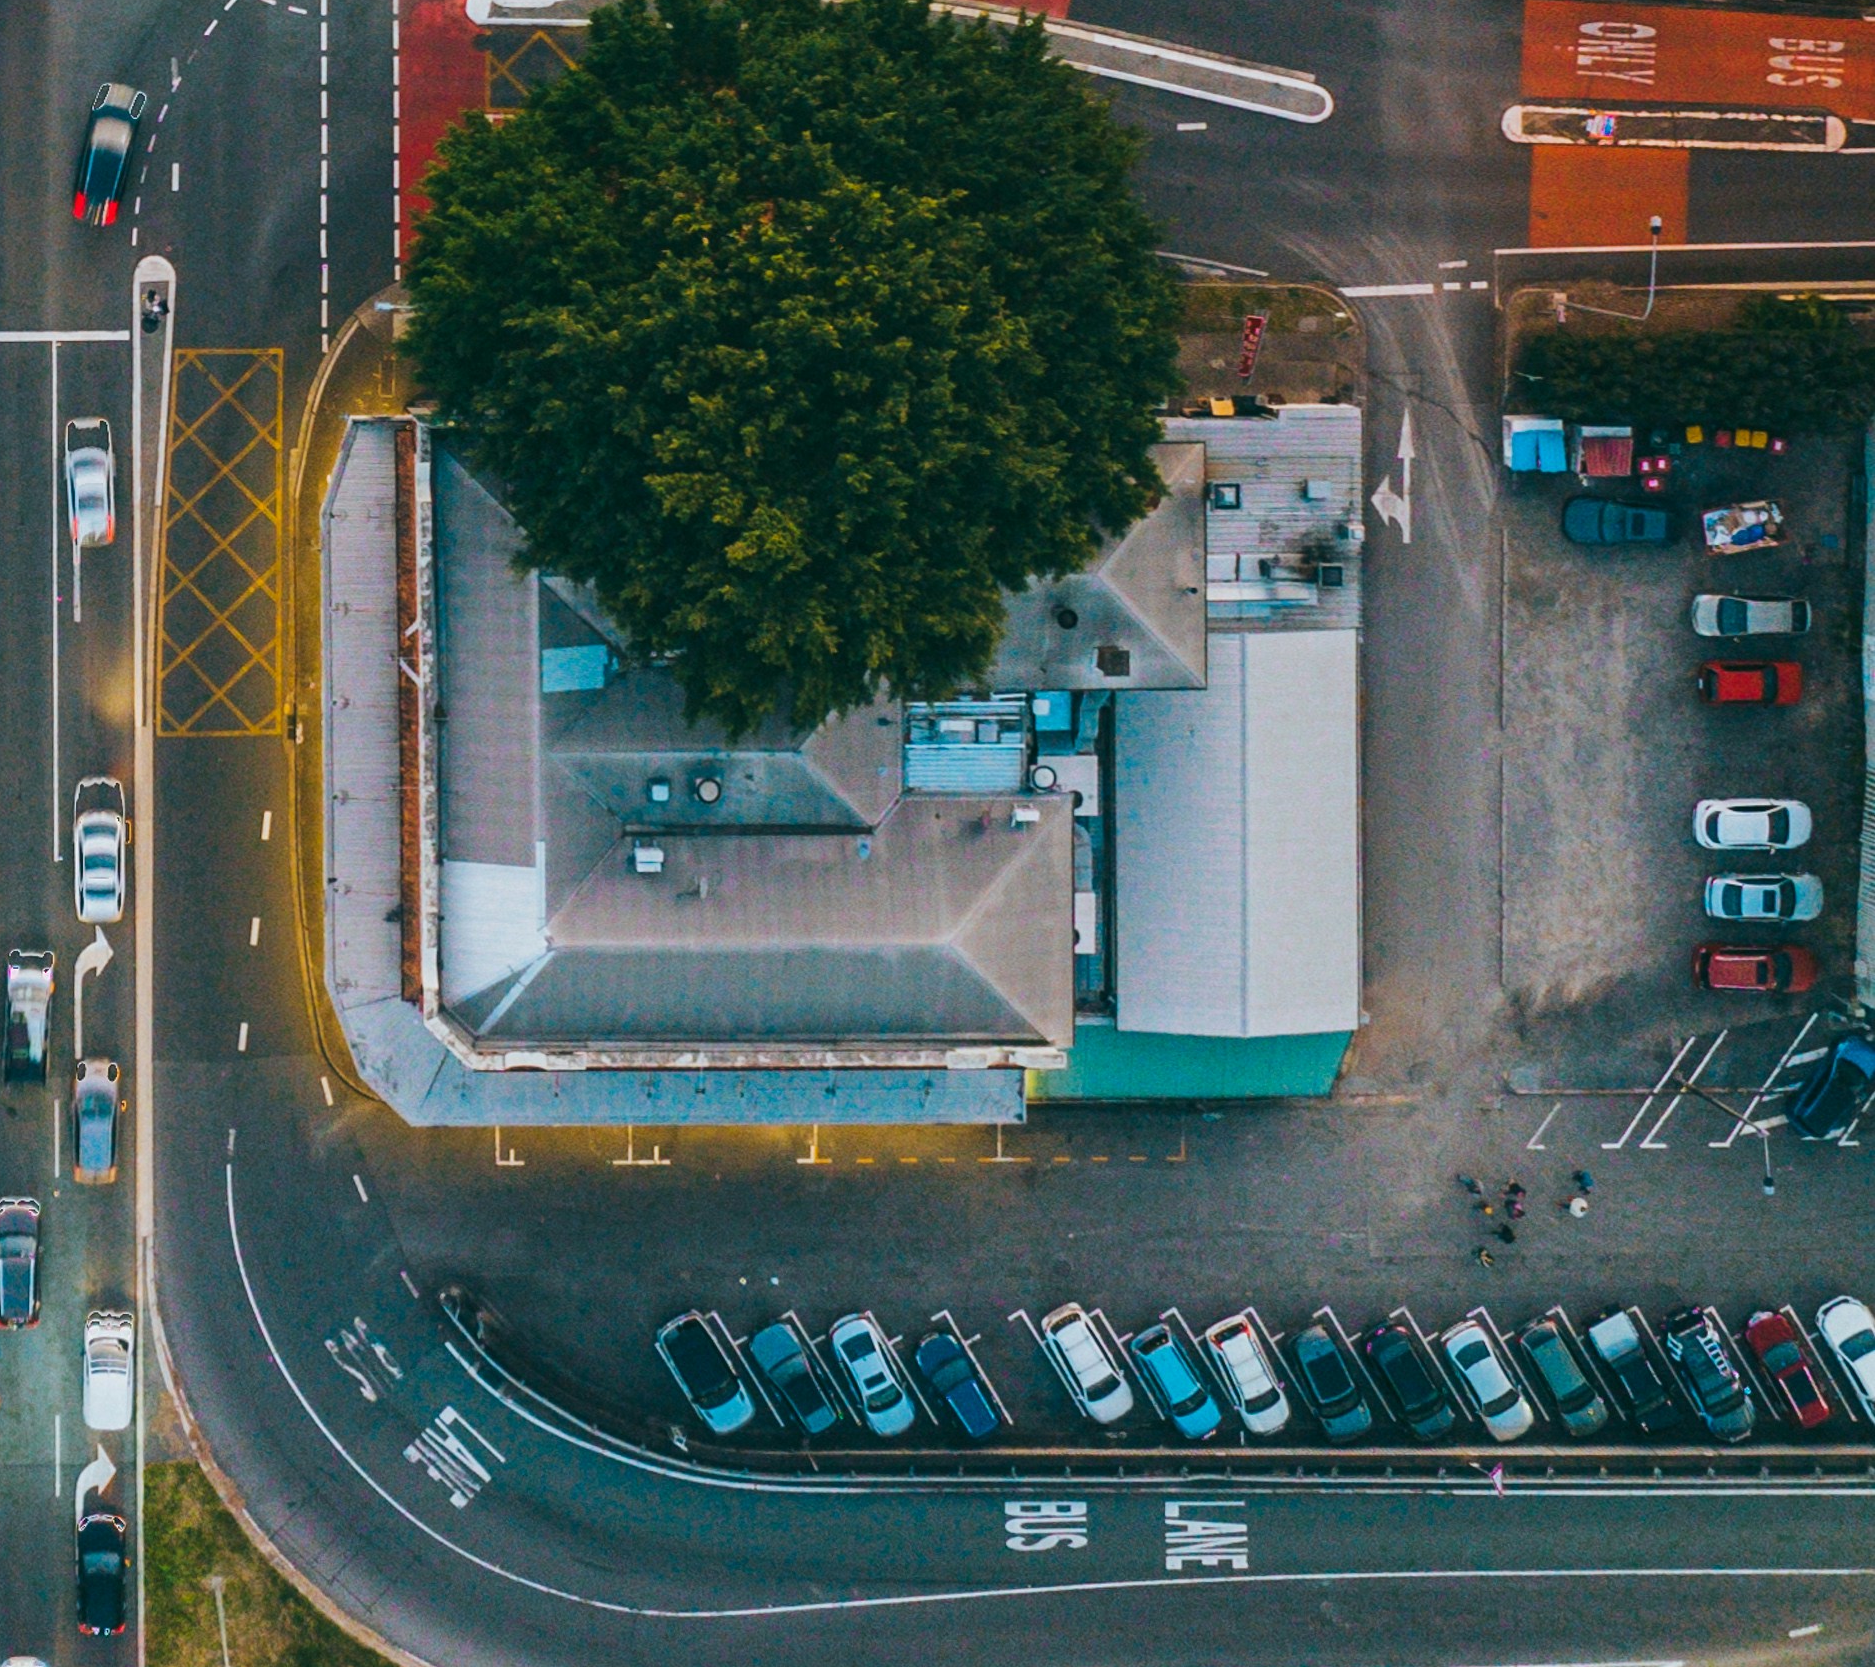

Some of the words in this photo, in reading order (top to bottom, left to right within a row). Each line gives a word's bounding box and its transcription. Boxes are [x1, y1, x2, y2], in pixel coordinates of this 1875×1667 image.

[1576, 21, 1657, 86] ONLY
[1766, 37, 1845, 89] BUS
[402, 1405, 507, 1510] LANE
[1004, 1500, 1088, 1552] BUS
[1164, 1500, 1249, 1571] LANE
